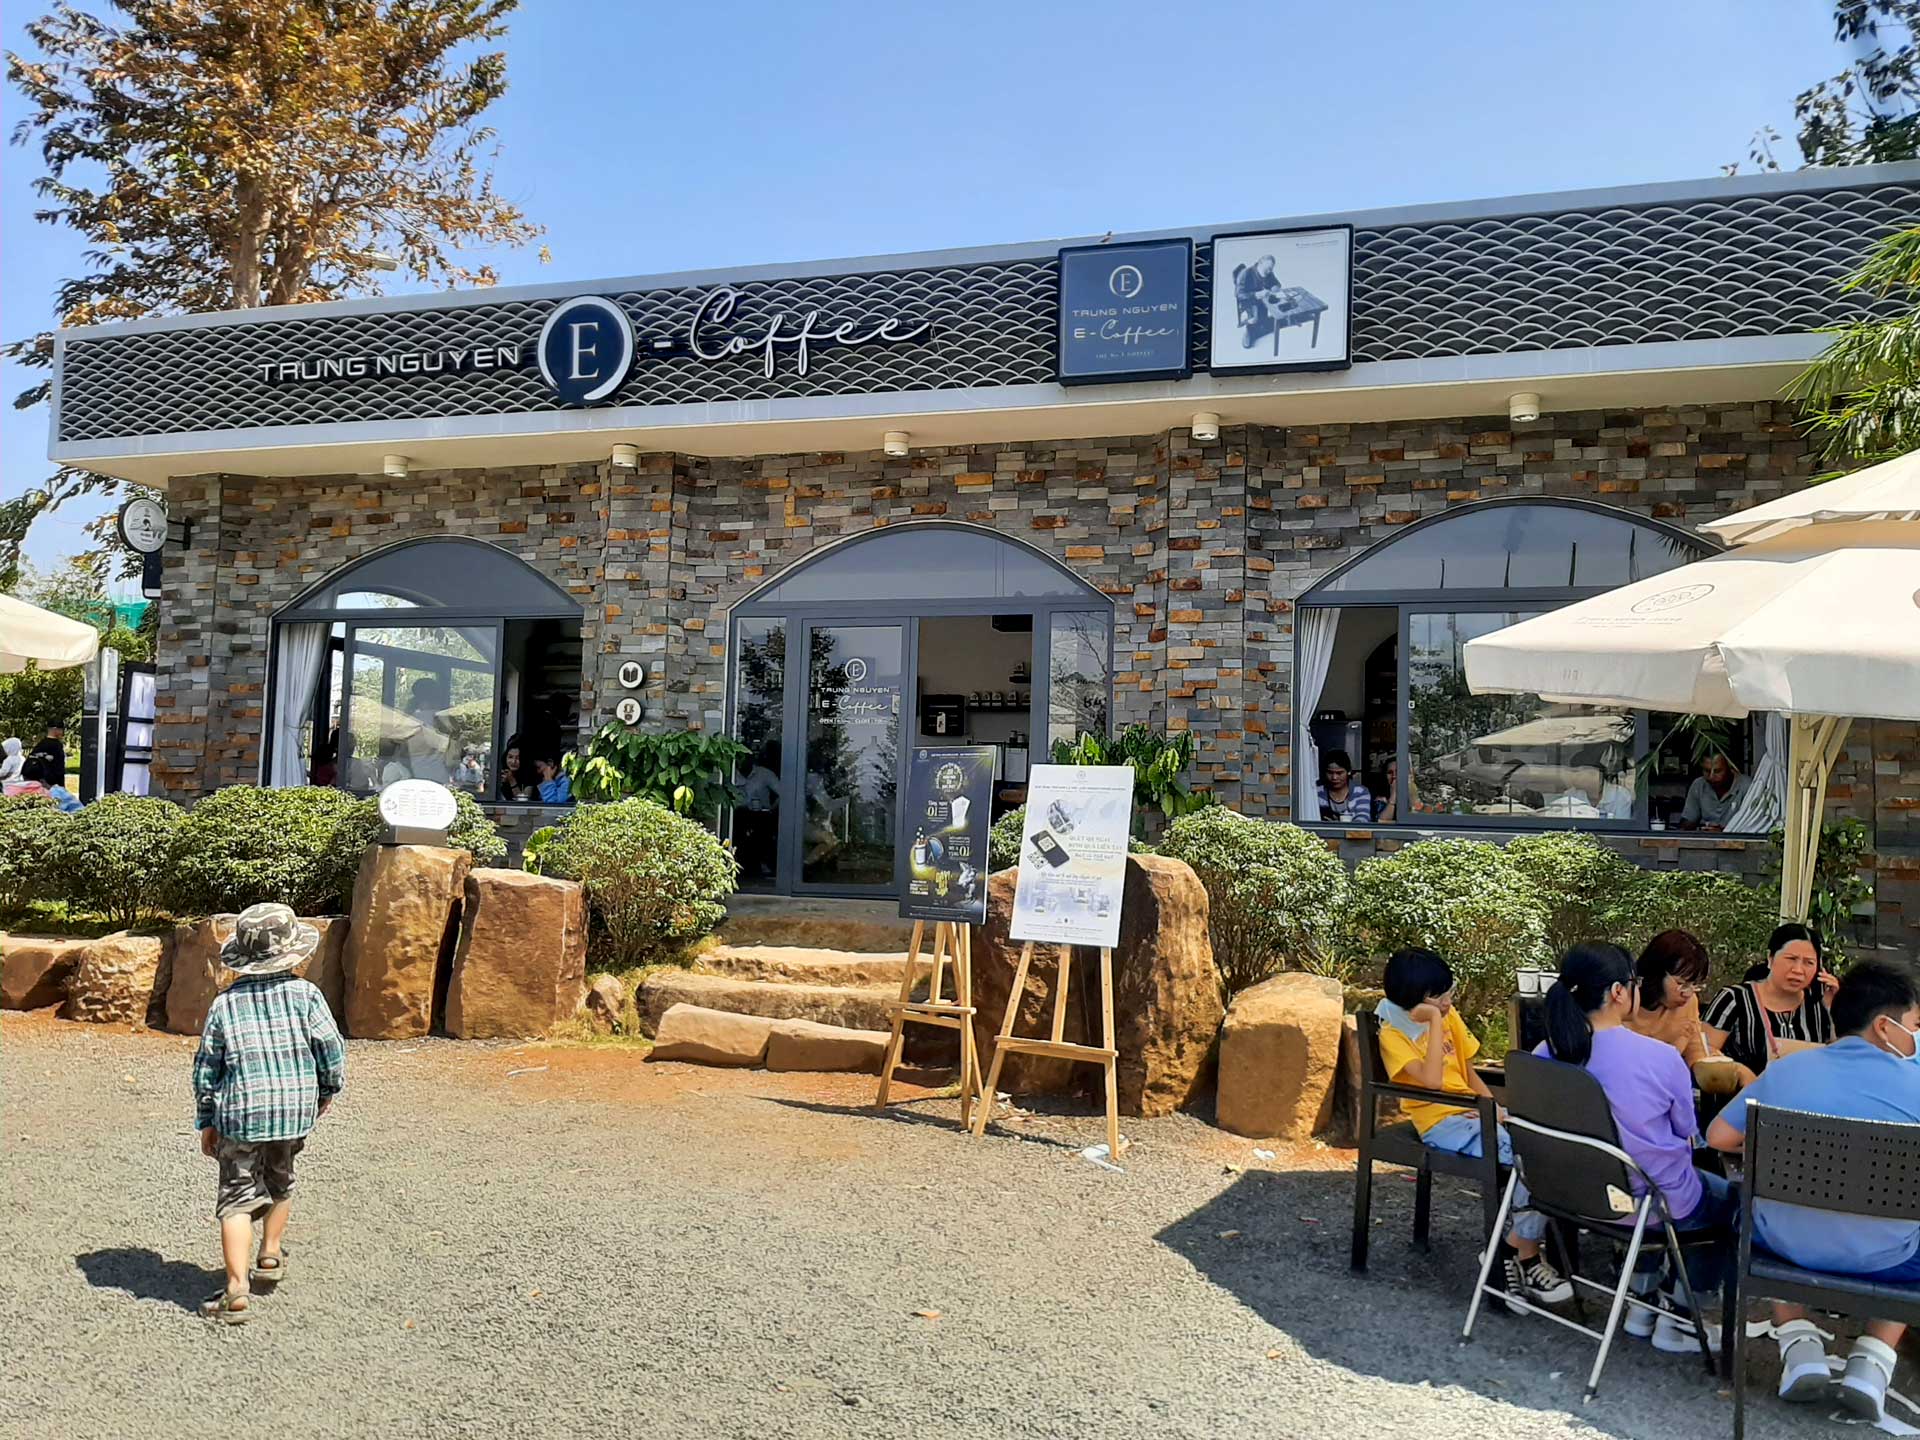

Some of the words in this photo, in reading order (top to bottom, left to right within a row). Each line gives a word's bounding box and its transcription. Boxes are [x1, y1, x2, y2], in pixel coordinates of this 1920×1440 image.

[258, 358, 366, 382] TRUNG
[376, 346, 518, 375] NGUYEN
[689, 287, 931, 378] Coffee
[1072, 308, 1118, 317] TRUNG
[1122, 303, 1178, 314] NGUYEN
